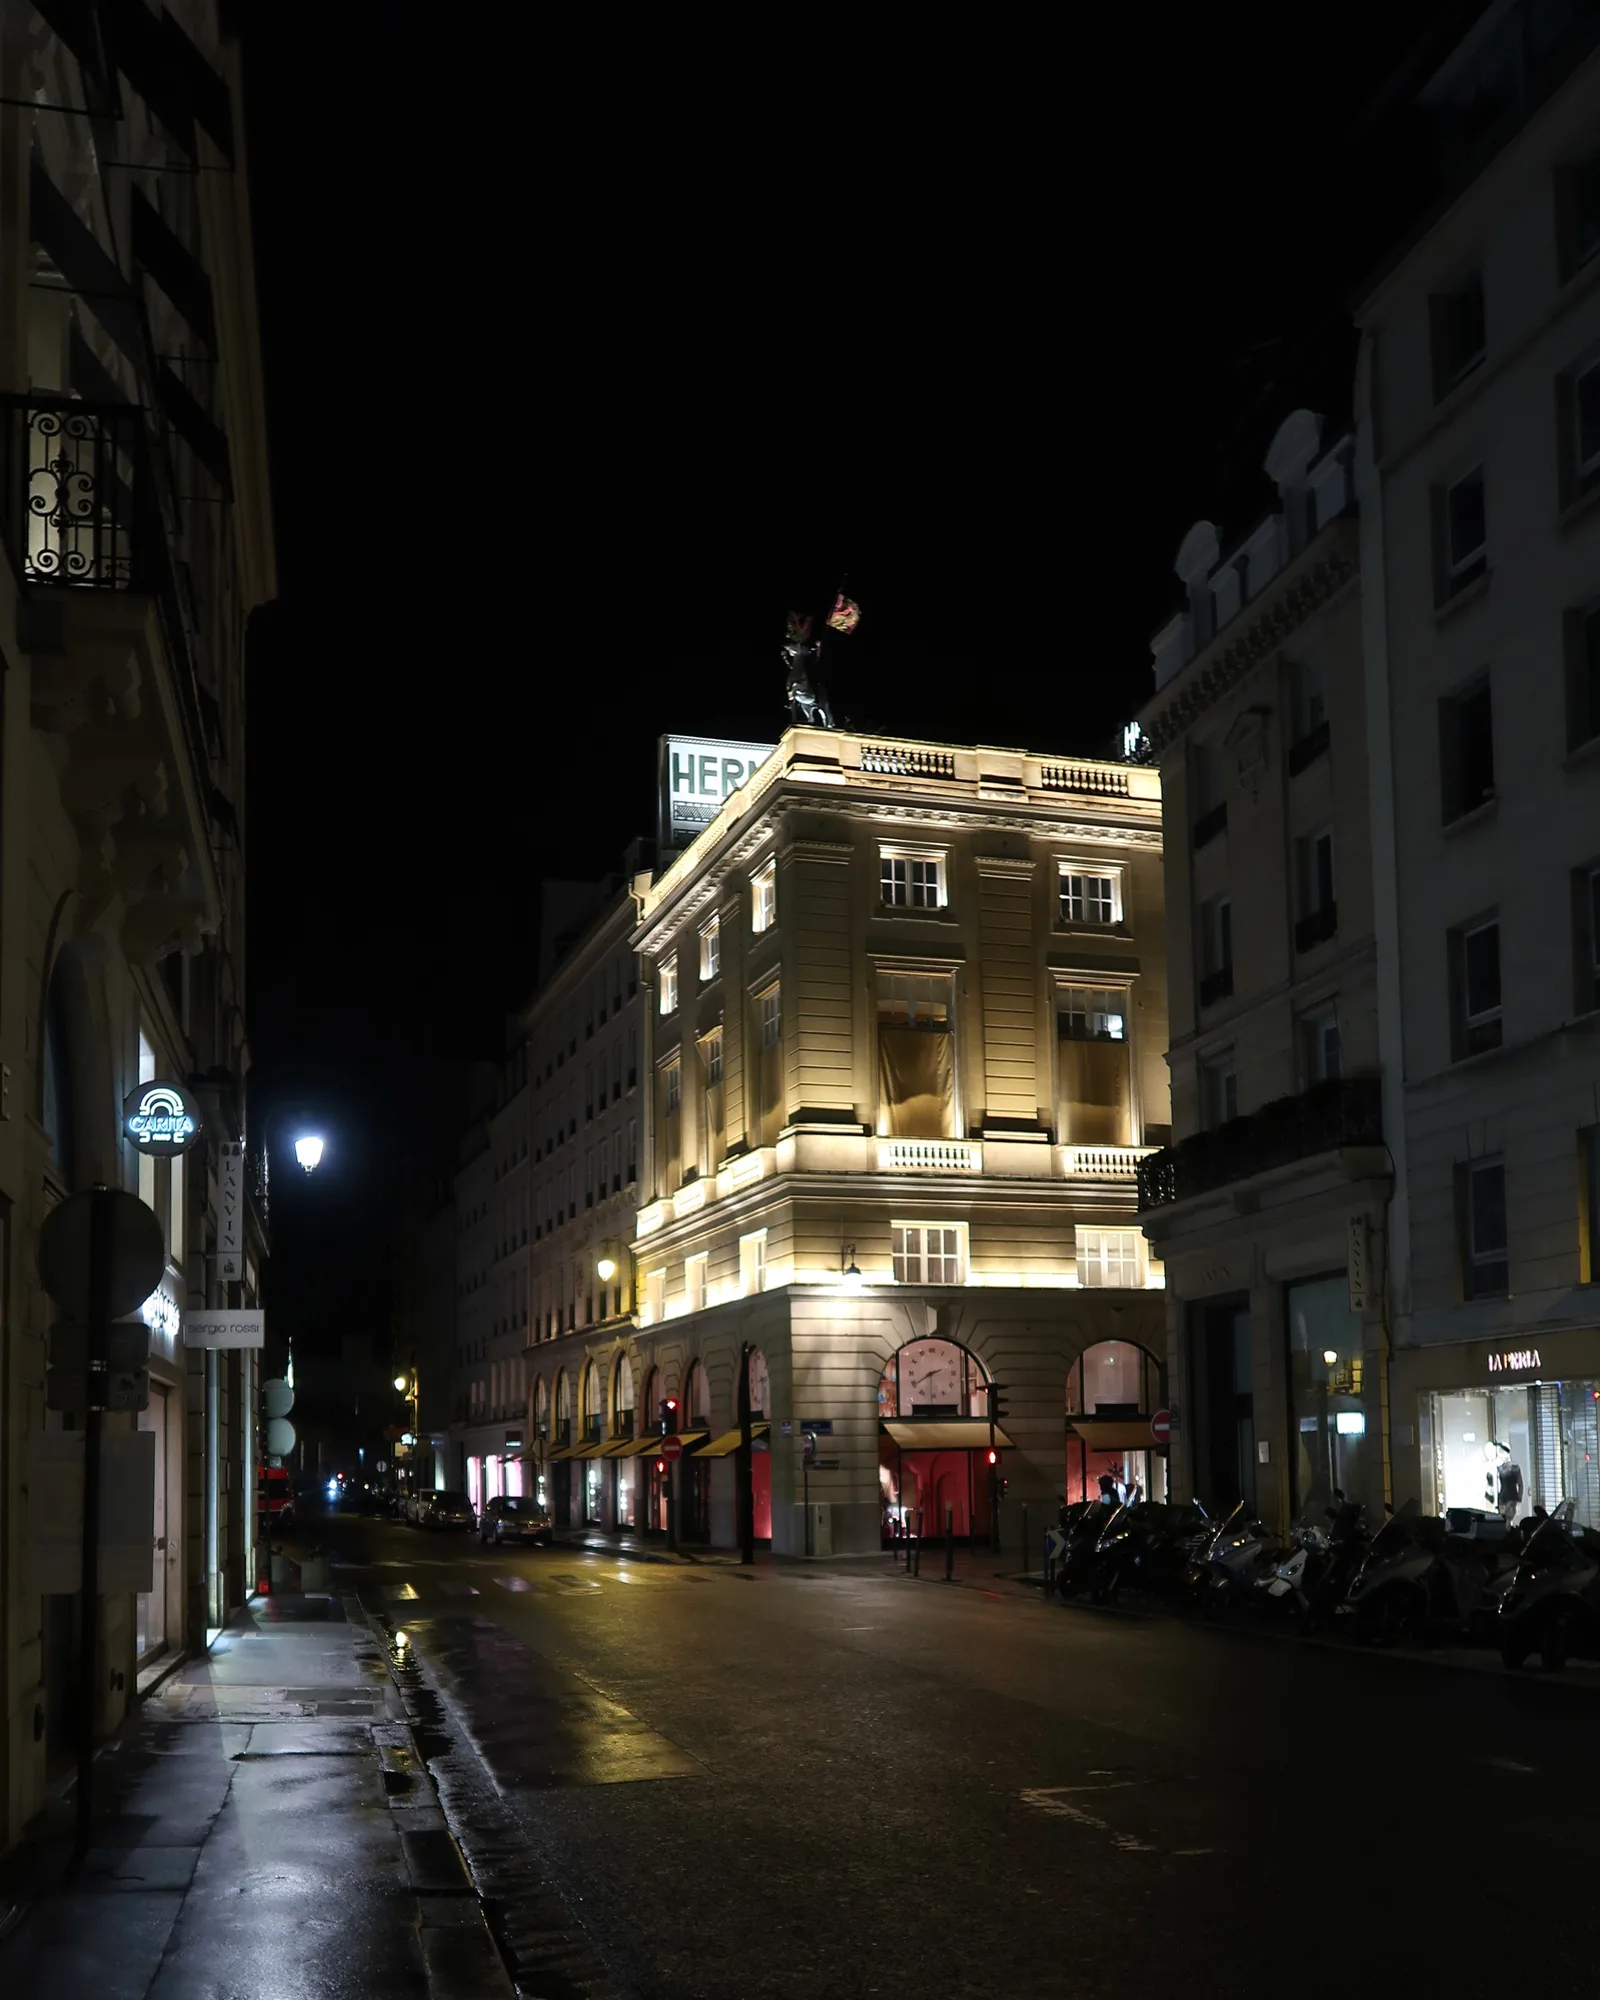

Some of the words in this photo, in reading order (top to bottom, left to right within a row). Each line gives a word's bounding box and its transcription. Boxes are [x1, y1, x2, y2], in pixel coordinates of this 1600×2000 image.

[129, 1116, 194, 1133] CARITA
[223, 1160, 237, 1247] LANVIN
[188, 1324, 227, 1335] sergio
[230, 1324, 260, 1333] rossi
